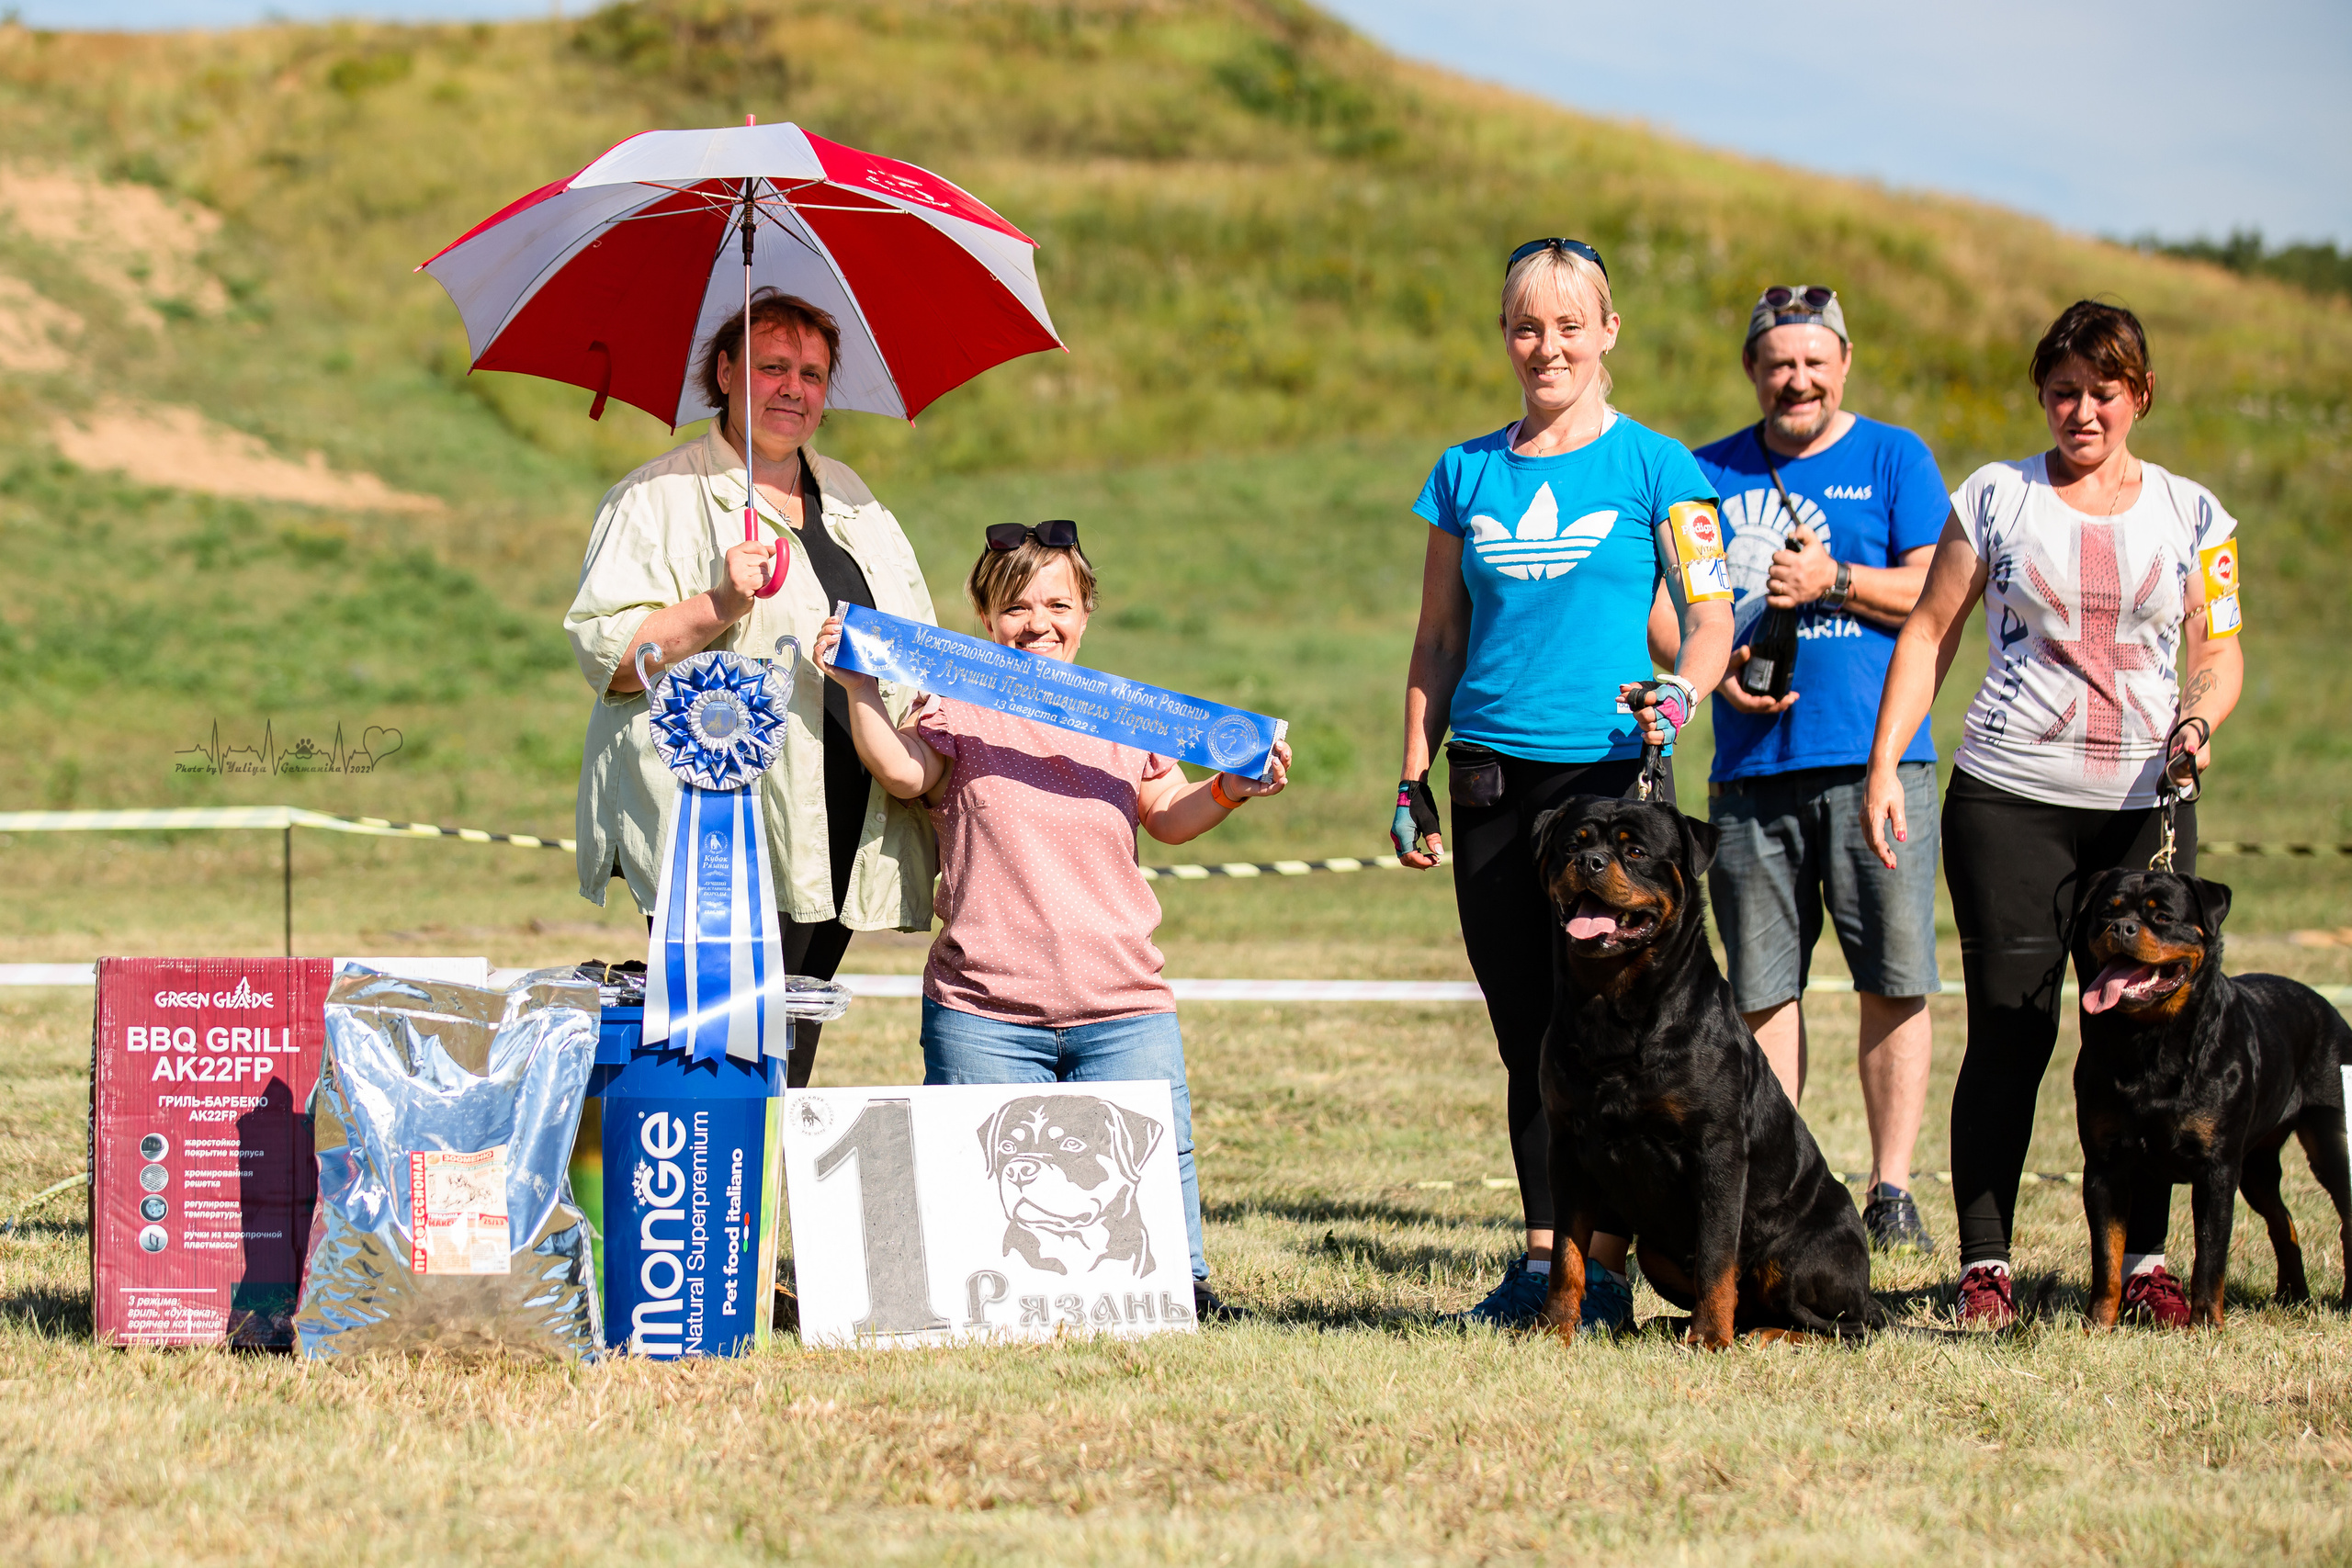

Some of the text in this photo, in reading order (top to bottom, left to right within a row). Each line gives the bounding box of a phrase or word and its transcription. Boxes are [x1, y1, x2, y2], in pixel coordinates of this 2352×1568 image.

[912, 627, 1210, 720] Межрегиональный Чемпионат «Кубок Рязани»
[937, 660, 998, 689] Лучший
[999, 675, 1111, 719] Представитель
[993, 698, 1100, 734] 13 августа 2022 г.
[704, 855, 728, 863] Кубок
[154, 982, 274, 1010] GREEN GLADE
[127, 1026, 300, 1054] BBQ GRILL
[152, 1056, 274, 1082] AK22FP
[158, 1096, 268, 1108] ГРИЛЬ-БАРБЕКЮ
[189, 1111, 237, 1122] AK22FP
[184, 1137, 241, 1147] жаростойкое
[184, 1149, 227, 1157] покрытие
[444, 1151, 493, 1163] ЗООМЕНЮ
[184, 1169, 254, 1179] хромированная
[184, 1179, 220, 1188] решетка
[184, 1201, 240, 1209] регулировка
[184, 1211, 243, 1220] температуры
[412, 1154, 425, 1271] ПРОФЕССИОНАЛ
[814, 1098, 951, 1336] 1
[184, 1231, 209, 1240] ручки
[223, 1231, 283, 1239] жаропрочной
[685, 1111, 710, 1355] Natural Superpremium
[722, 1148, 743, 1315] Pet food italiano
[184, 1241, 238, 1249] пластмассы
[128, 1295, 136, 1305] 3
[128, 1308, 161, 1319] гриль,
[128, 1320, 170, 1330] горячее
